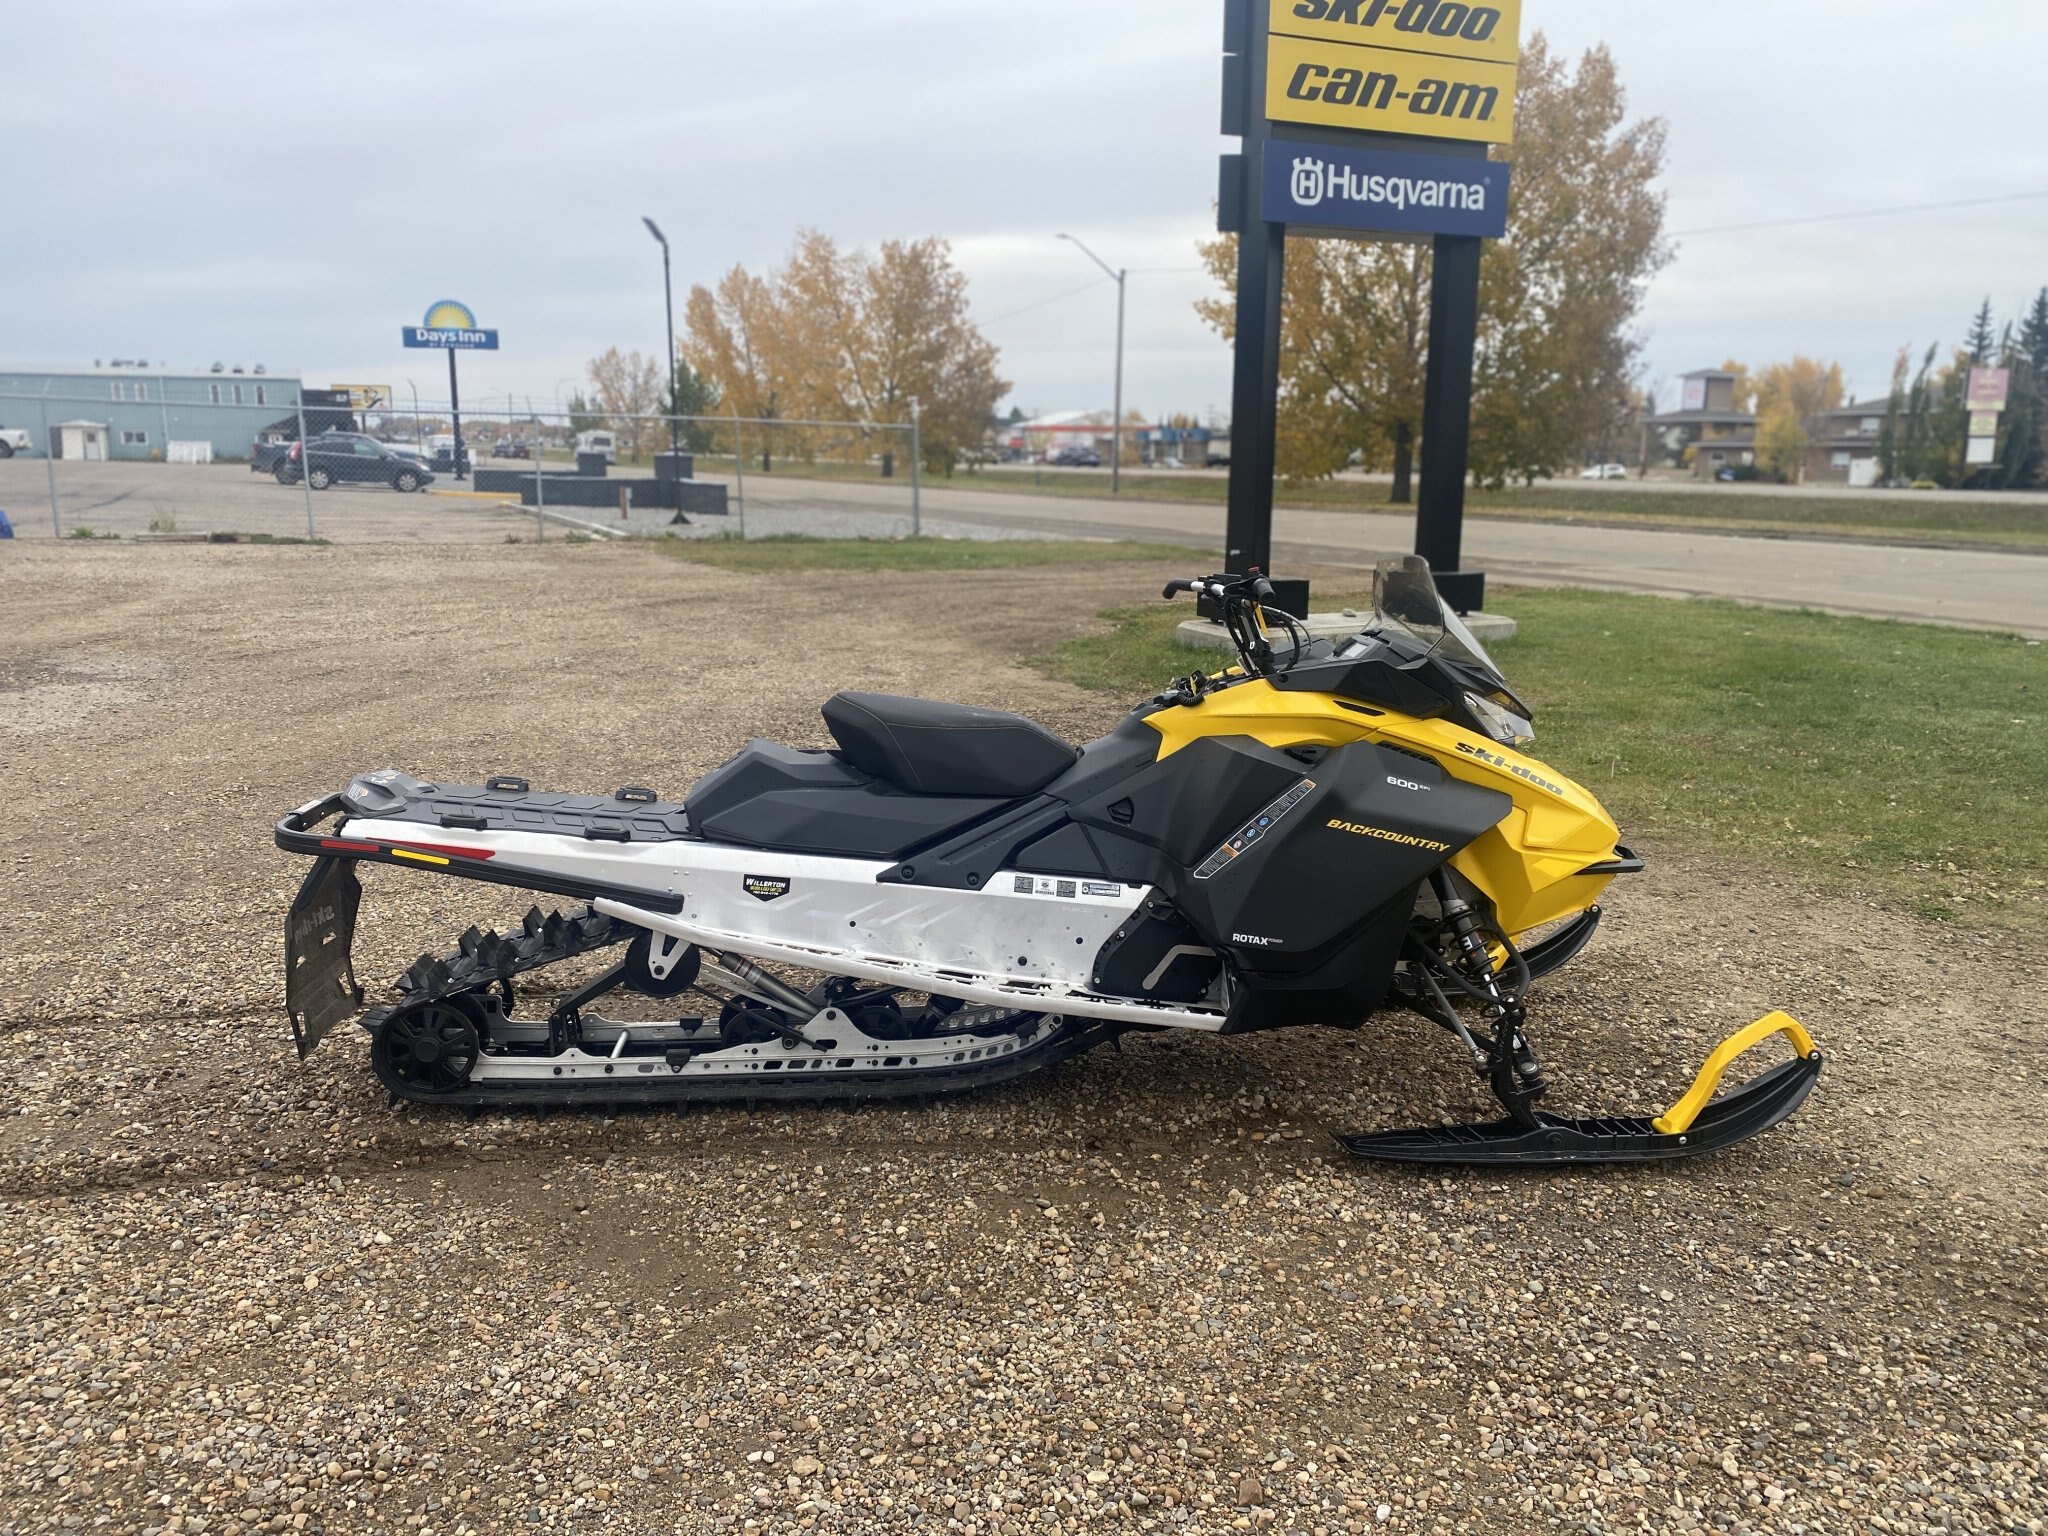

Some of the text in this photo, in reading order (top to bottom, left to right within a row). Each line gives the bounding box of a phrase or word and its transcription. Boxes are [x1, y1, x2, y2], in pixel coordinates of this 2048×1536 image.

[1286, 62, 1499, 121] can-am
[1327, 164, 1486, 210] Husqvarna
[416, 329, 486, 343] Days Inn
[1455, 742, 1563, 796] ski-doo
[1386, 776, 1418, 790] 600
[1326, 819, 1450, 852] BACKCOUNTRY
[746, 878, 786, 888] WILLERTON
[1232, 933, 1268, 945] ROTAX
